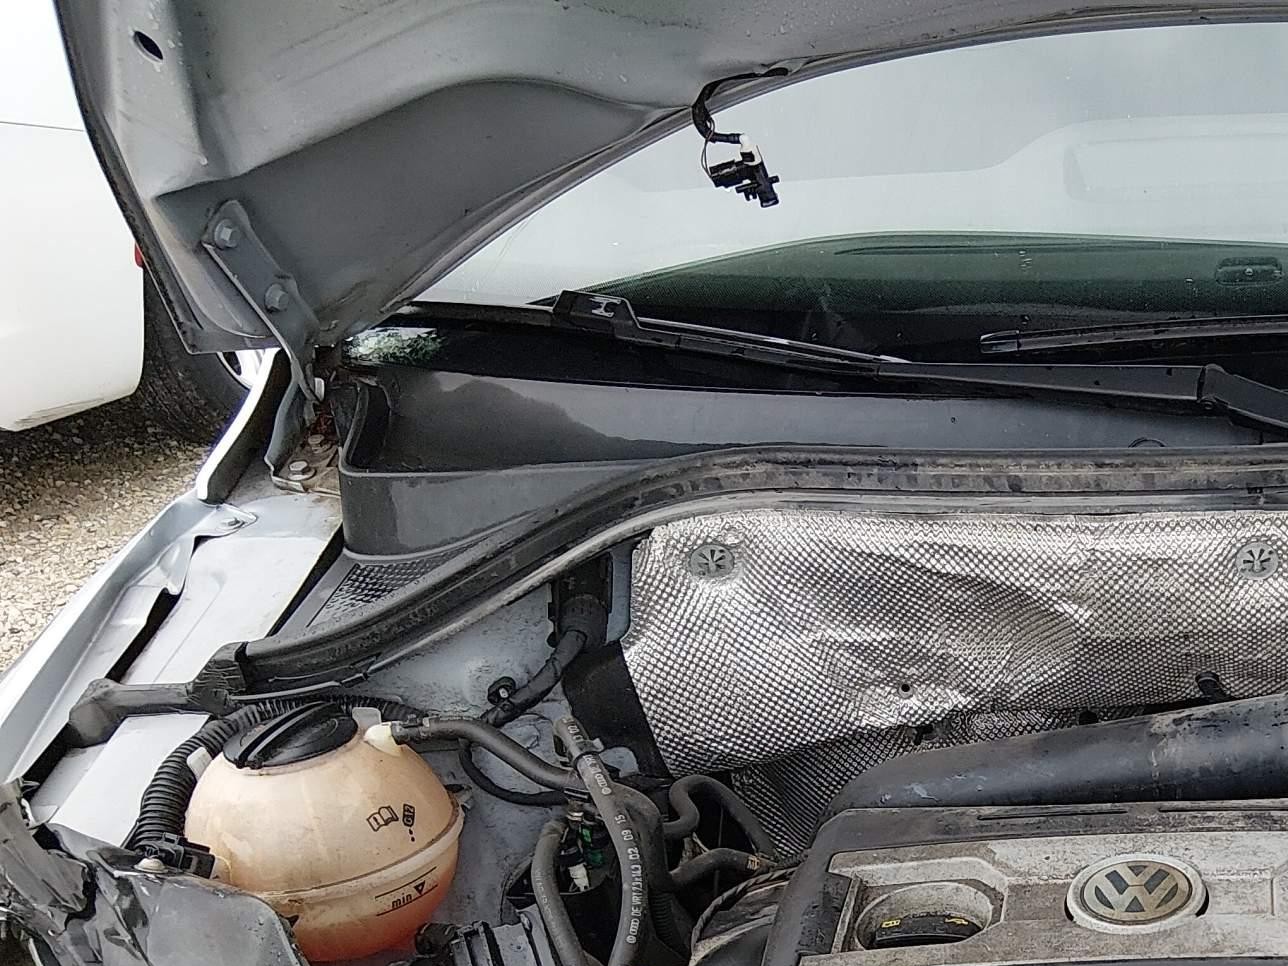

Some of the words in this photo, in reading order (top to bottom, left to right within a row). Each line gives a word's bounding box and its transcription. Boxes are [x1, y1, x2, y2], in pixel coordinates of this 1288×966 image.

[614, 814, 627, 824] 15
[621, 829, 634, 841] 09
[627, 846, 640, 860] 02
[1081, 859, 1193, 924] VW
[391, 893, 413, 909] min
